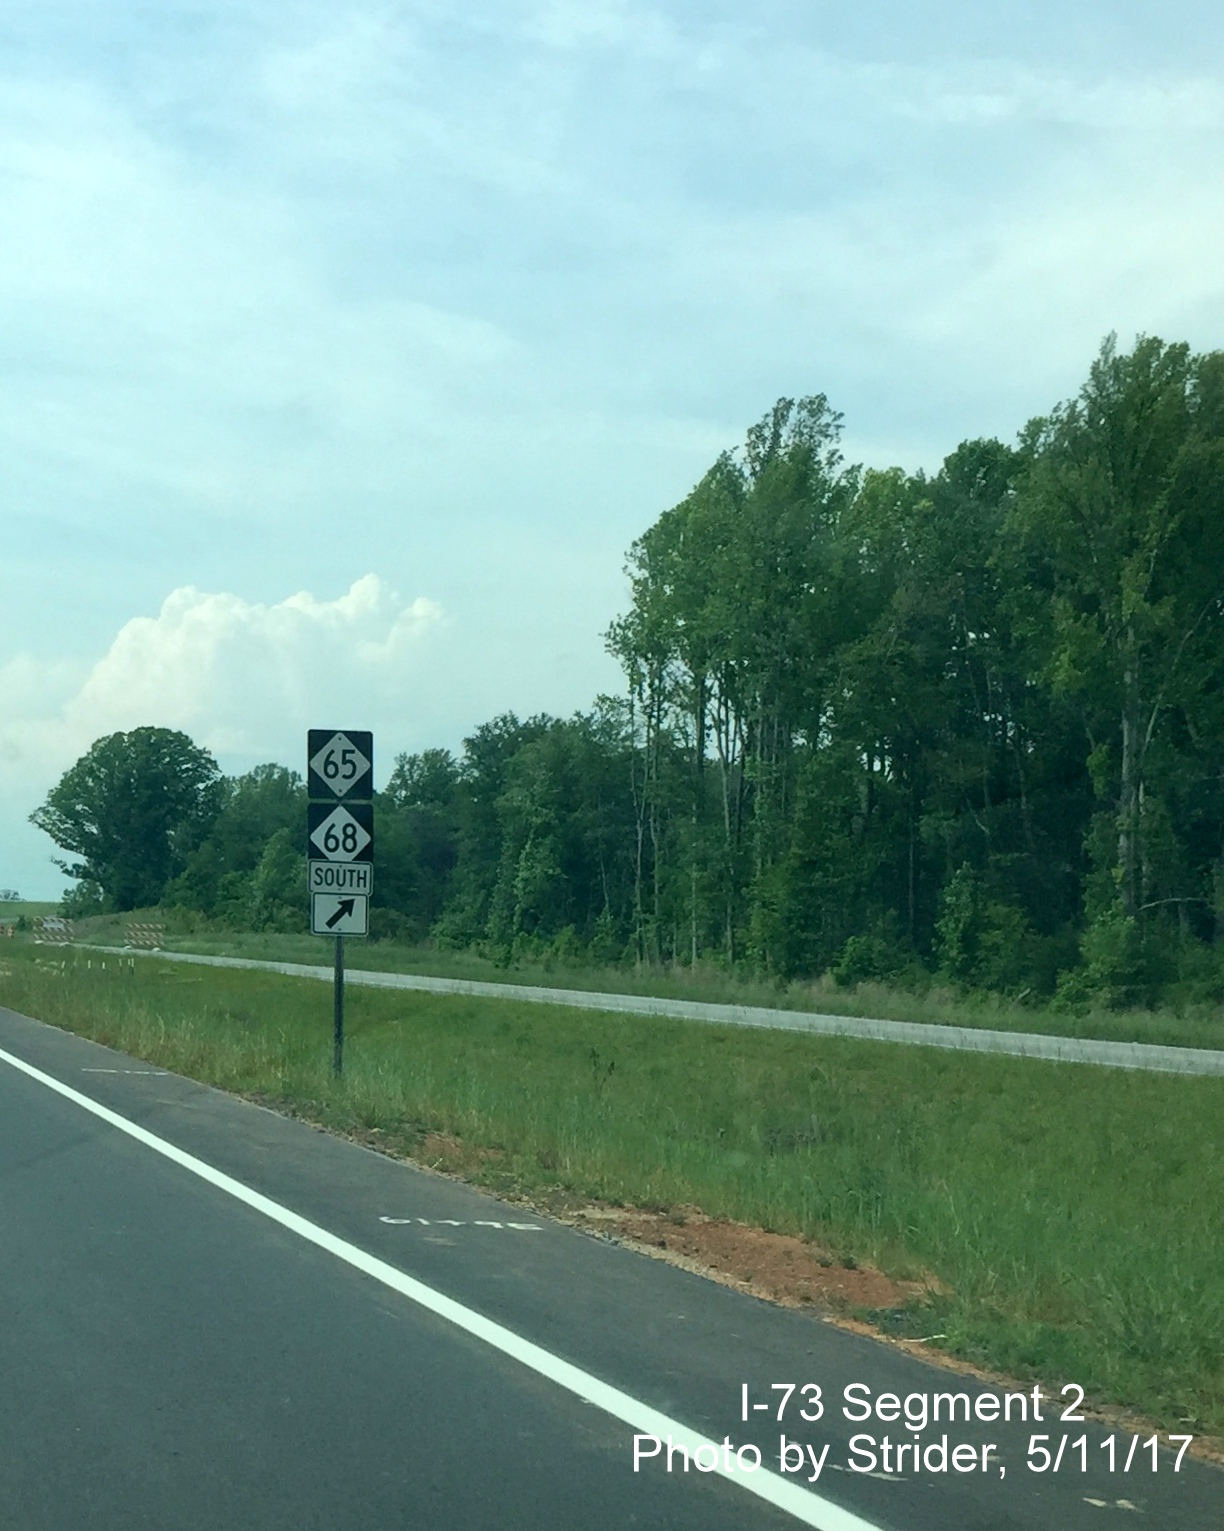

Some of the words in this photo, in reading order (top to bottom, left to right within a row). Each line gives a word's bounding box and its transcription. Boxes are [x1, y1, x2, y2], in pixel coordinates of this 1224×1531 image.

[323, 749, 357, 779] 65
[323, 823, 358, 853] 68
[314, 868, 367, 888] SOUTH
